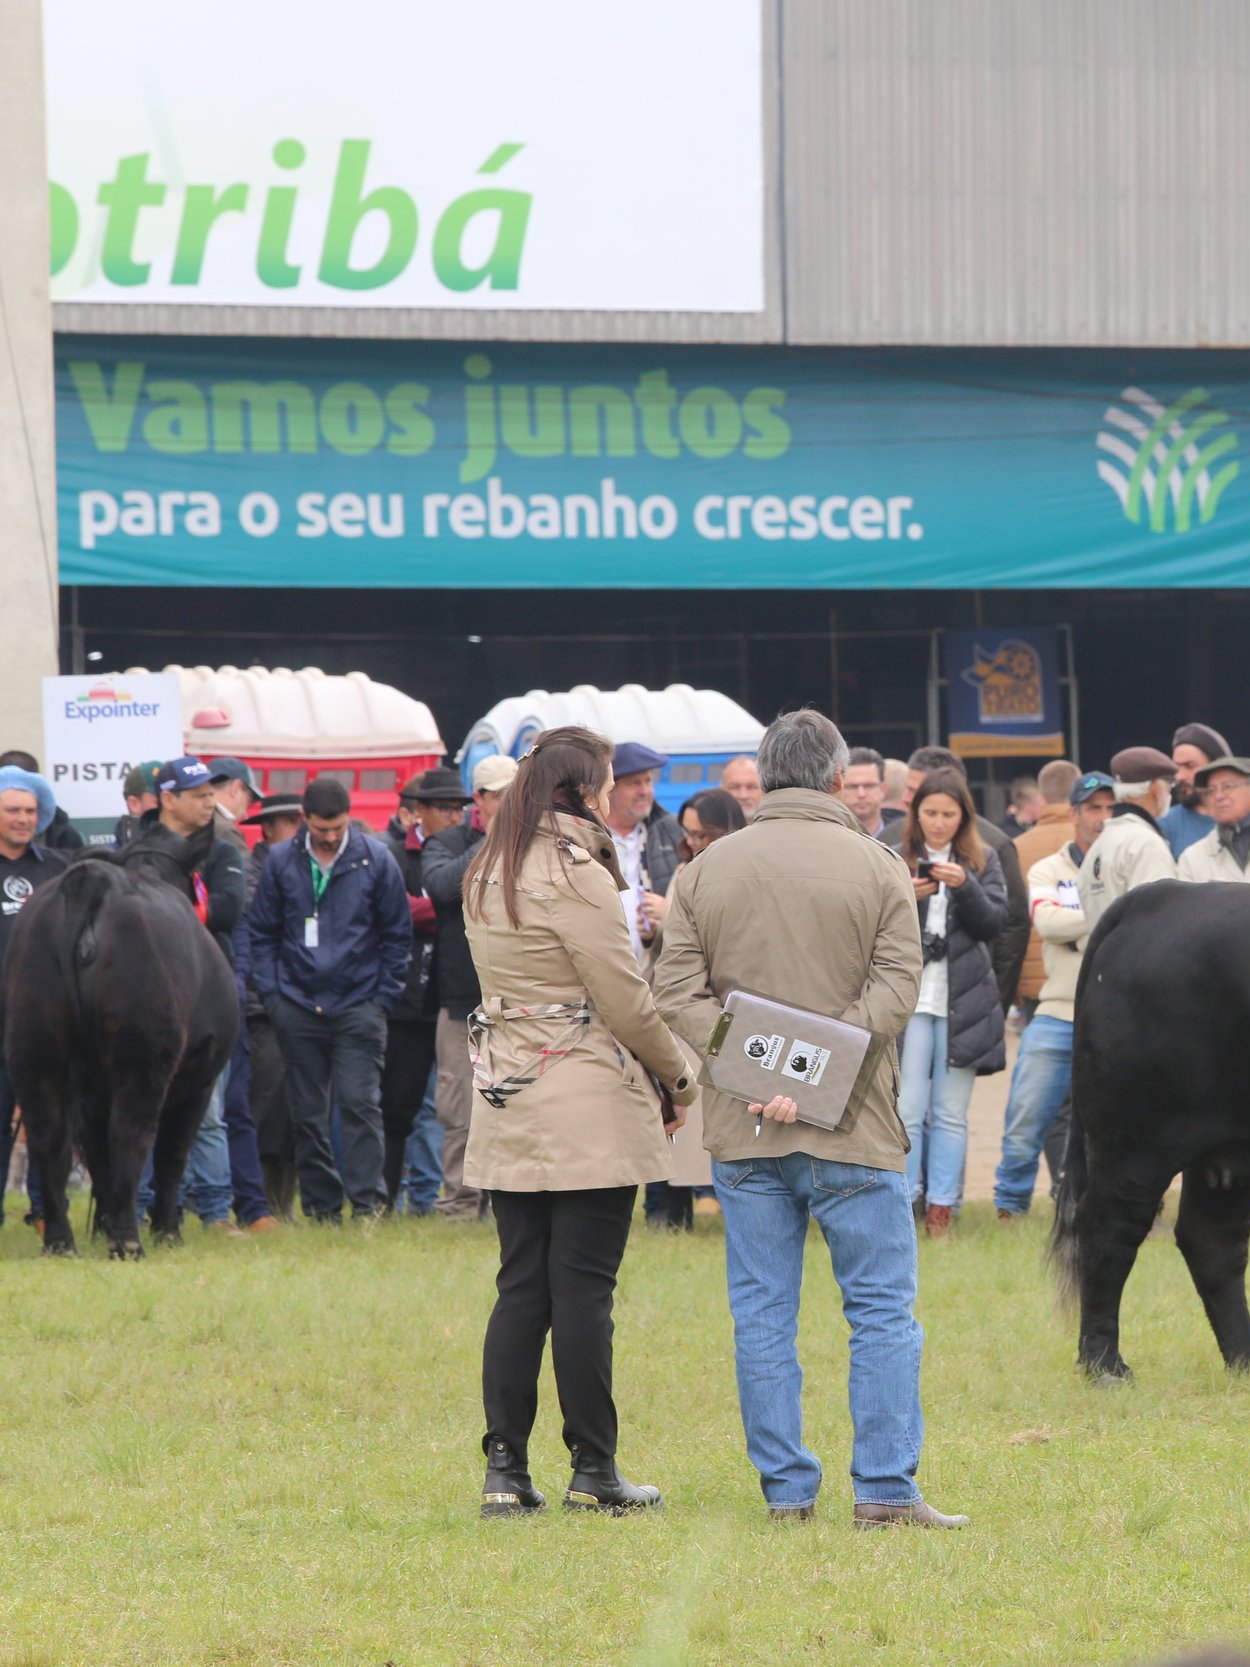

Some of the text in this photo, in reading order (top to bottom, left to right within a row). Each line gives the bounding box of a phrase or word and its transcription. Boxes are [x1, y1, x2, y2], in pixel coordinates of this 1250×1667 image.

[68, 353, 791, 484] Vamos juntos
[79, 476, 924, 549] para o seu rebanho crescer.
[64, 701, 160, 723] Expointer
[763, 1037, 780, 1067] Brangus
[804, 1047, 823, 1083] BRANGUS
